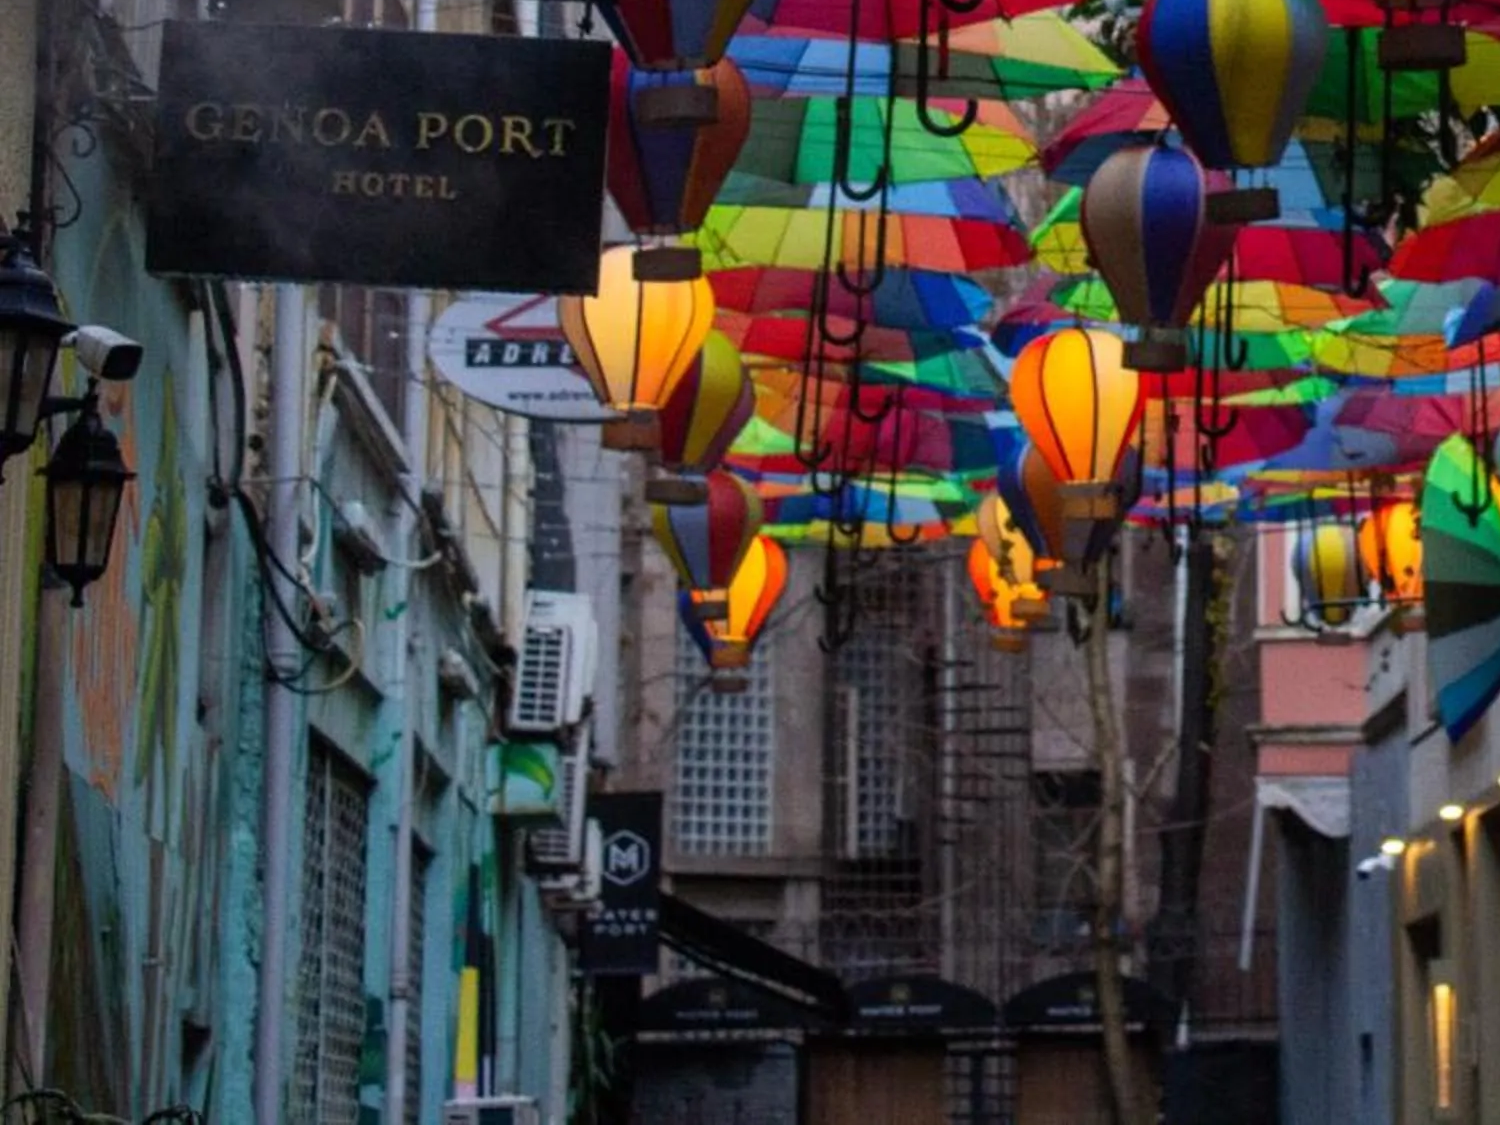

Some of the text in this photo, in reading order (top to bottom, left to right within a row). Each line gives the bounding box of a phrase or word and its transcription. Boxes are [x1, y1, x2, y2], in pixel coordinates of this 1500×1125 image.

[186, 101, 576, 157] GENOA PORT
[331, 170, 458, 201] HOTEL
